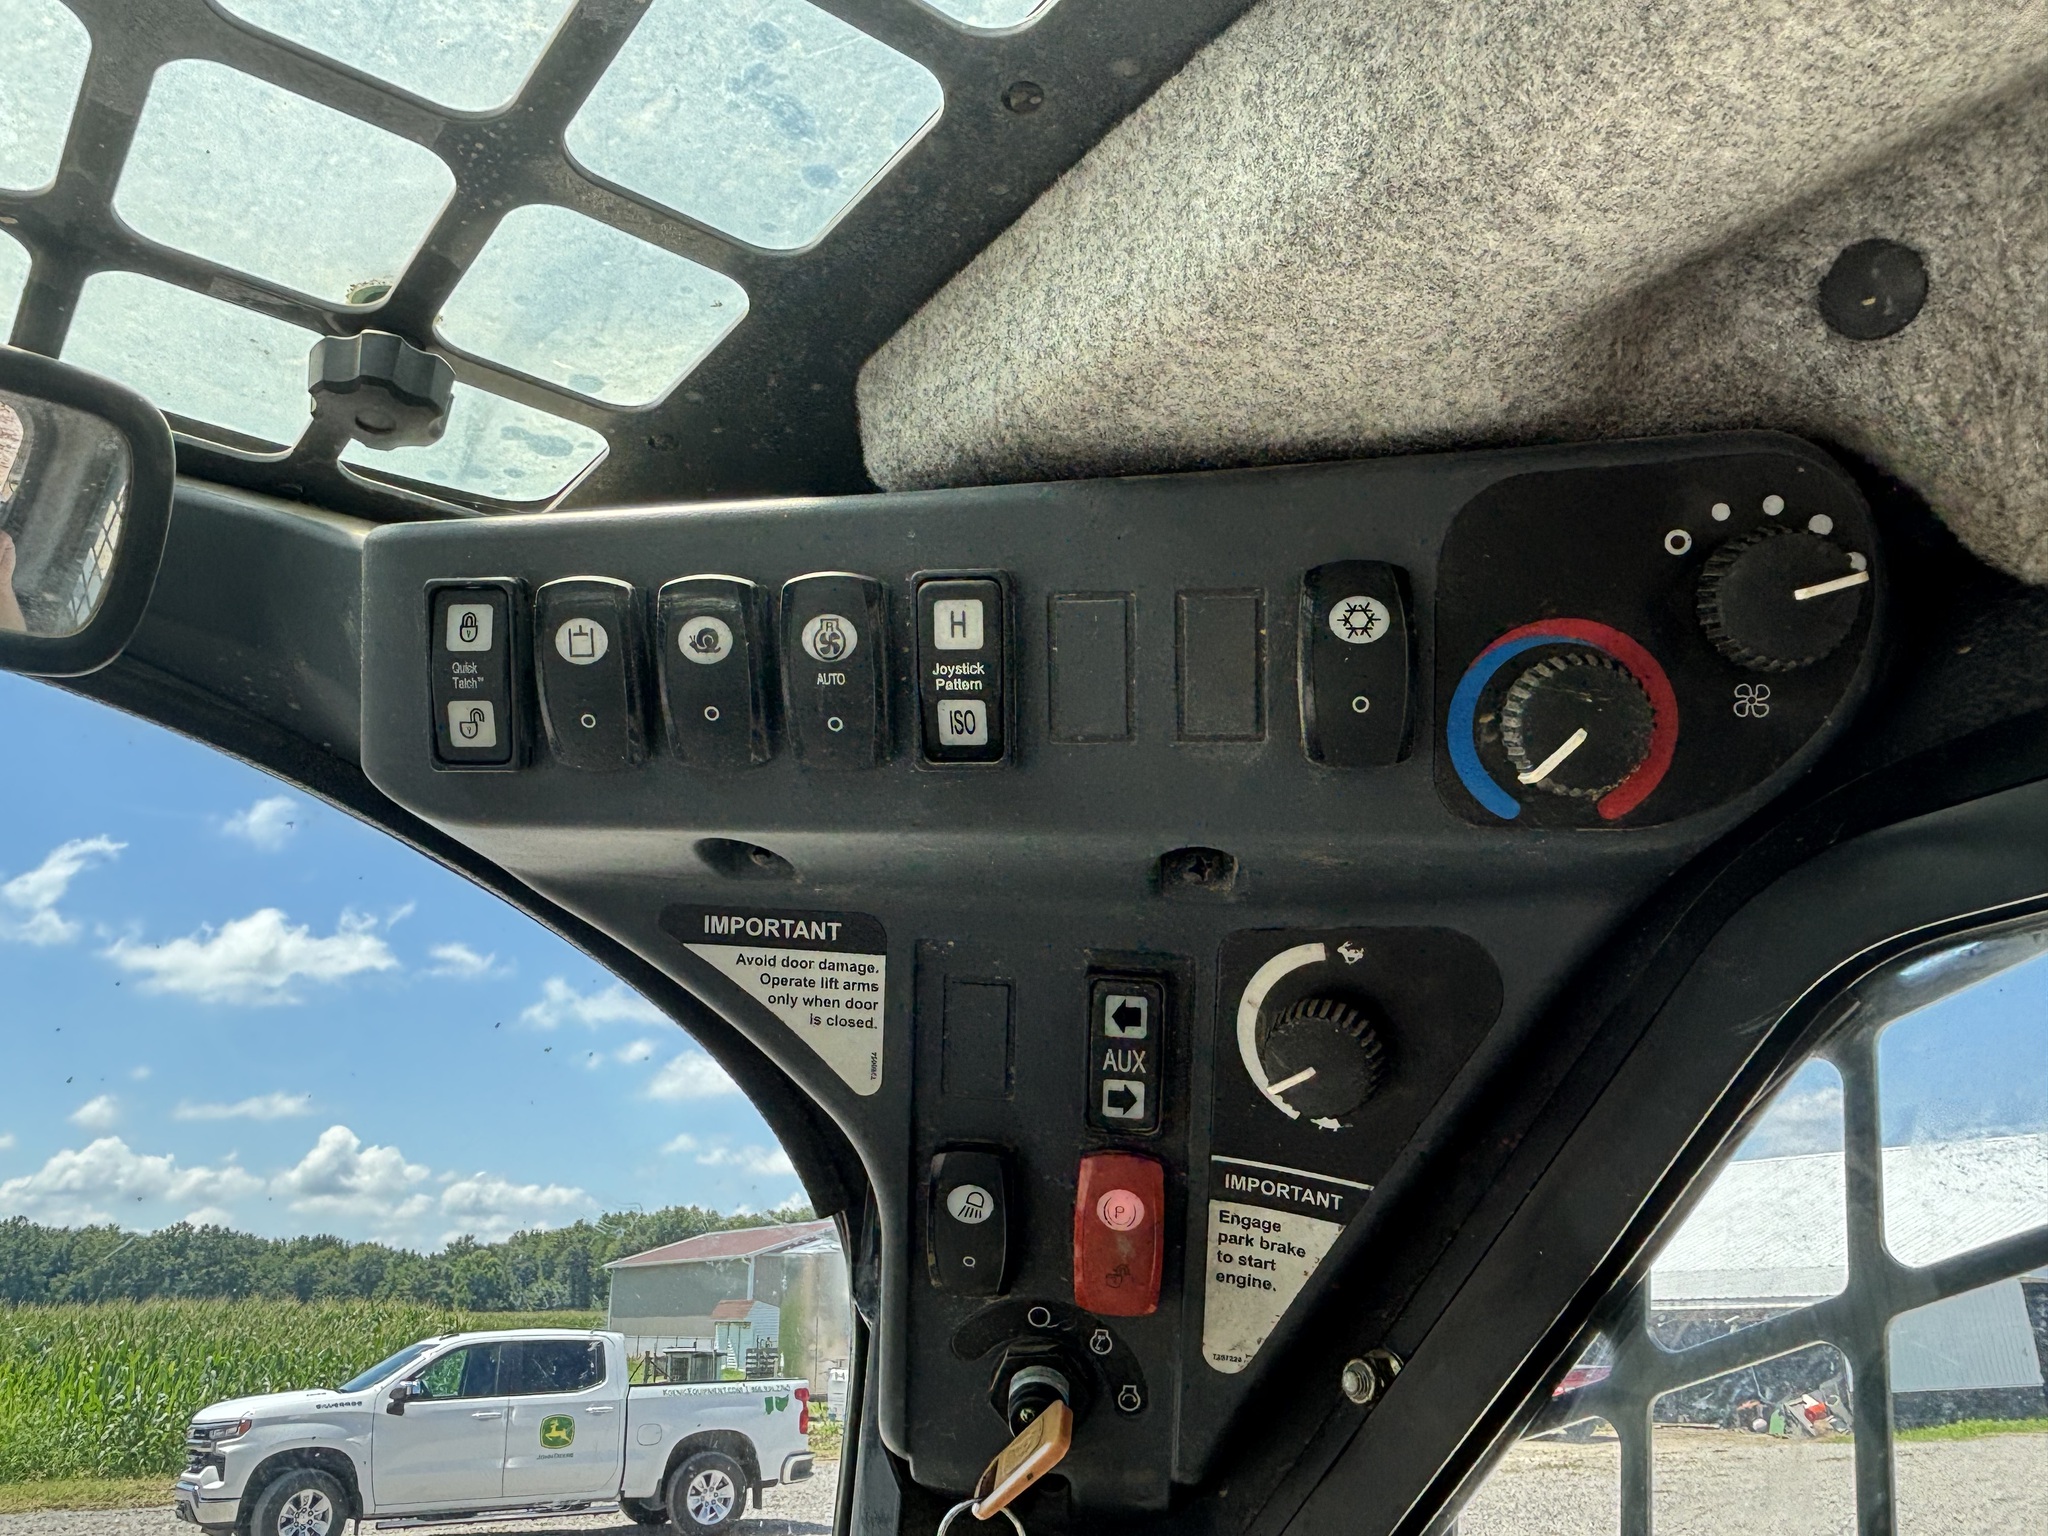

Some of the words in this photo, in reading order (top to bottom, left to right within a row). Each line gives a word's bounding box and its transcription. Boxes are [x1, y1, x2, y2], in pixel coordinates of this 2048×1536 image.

[950, 610, 967, 638] H
[816, 672, 846, 686] AUTO
[932, 662, 986, 678] Joystick
[935, 678, 983, 691] Pattern
[949, 709, 977, 736] ISO
[703, 914, 842, 941] IMPORTANT
[735, 953, 777, 968] Avoid
[780, 956, 815, 970] door
[818, 958, 880, 976] damage.
[759, 972, 816, 989] Operate
[820, 976, 839, 990] lift
[842, 980, 879, 992] arms
[767, 993, 799, 1009] only
[802, 996, 840, 1009] when
[844, 998, 879, 1011] door
[809, 1013, 822, 1026] is
[826, 1015, 878, 1030] closed.
[1102, 1048, 1147, 1074] AUX
[1224, 1173, 1344, 1211] IMPORTANT
[1219, 1209, 1282, 1234] Engage
[1218, 1232, 1255, 1247] park
[1259, 1236, 1306, 1258] brake
[1216, 1250, 1234, 1264] to
[1238, 1255, 1277, 1272] start
[1215, 1271, 1277, 1292] engine.
